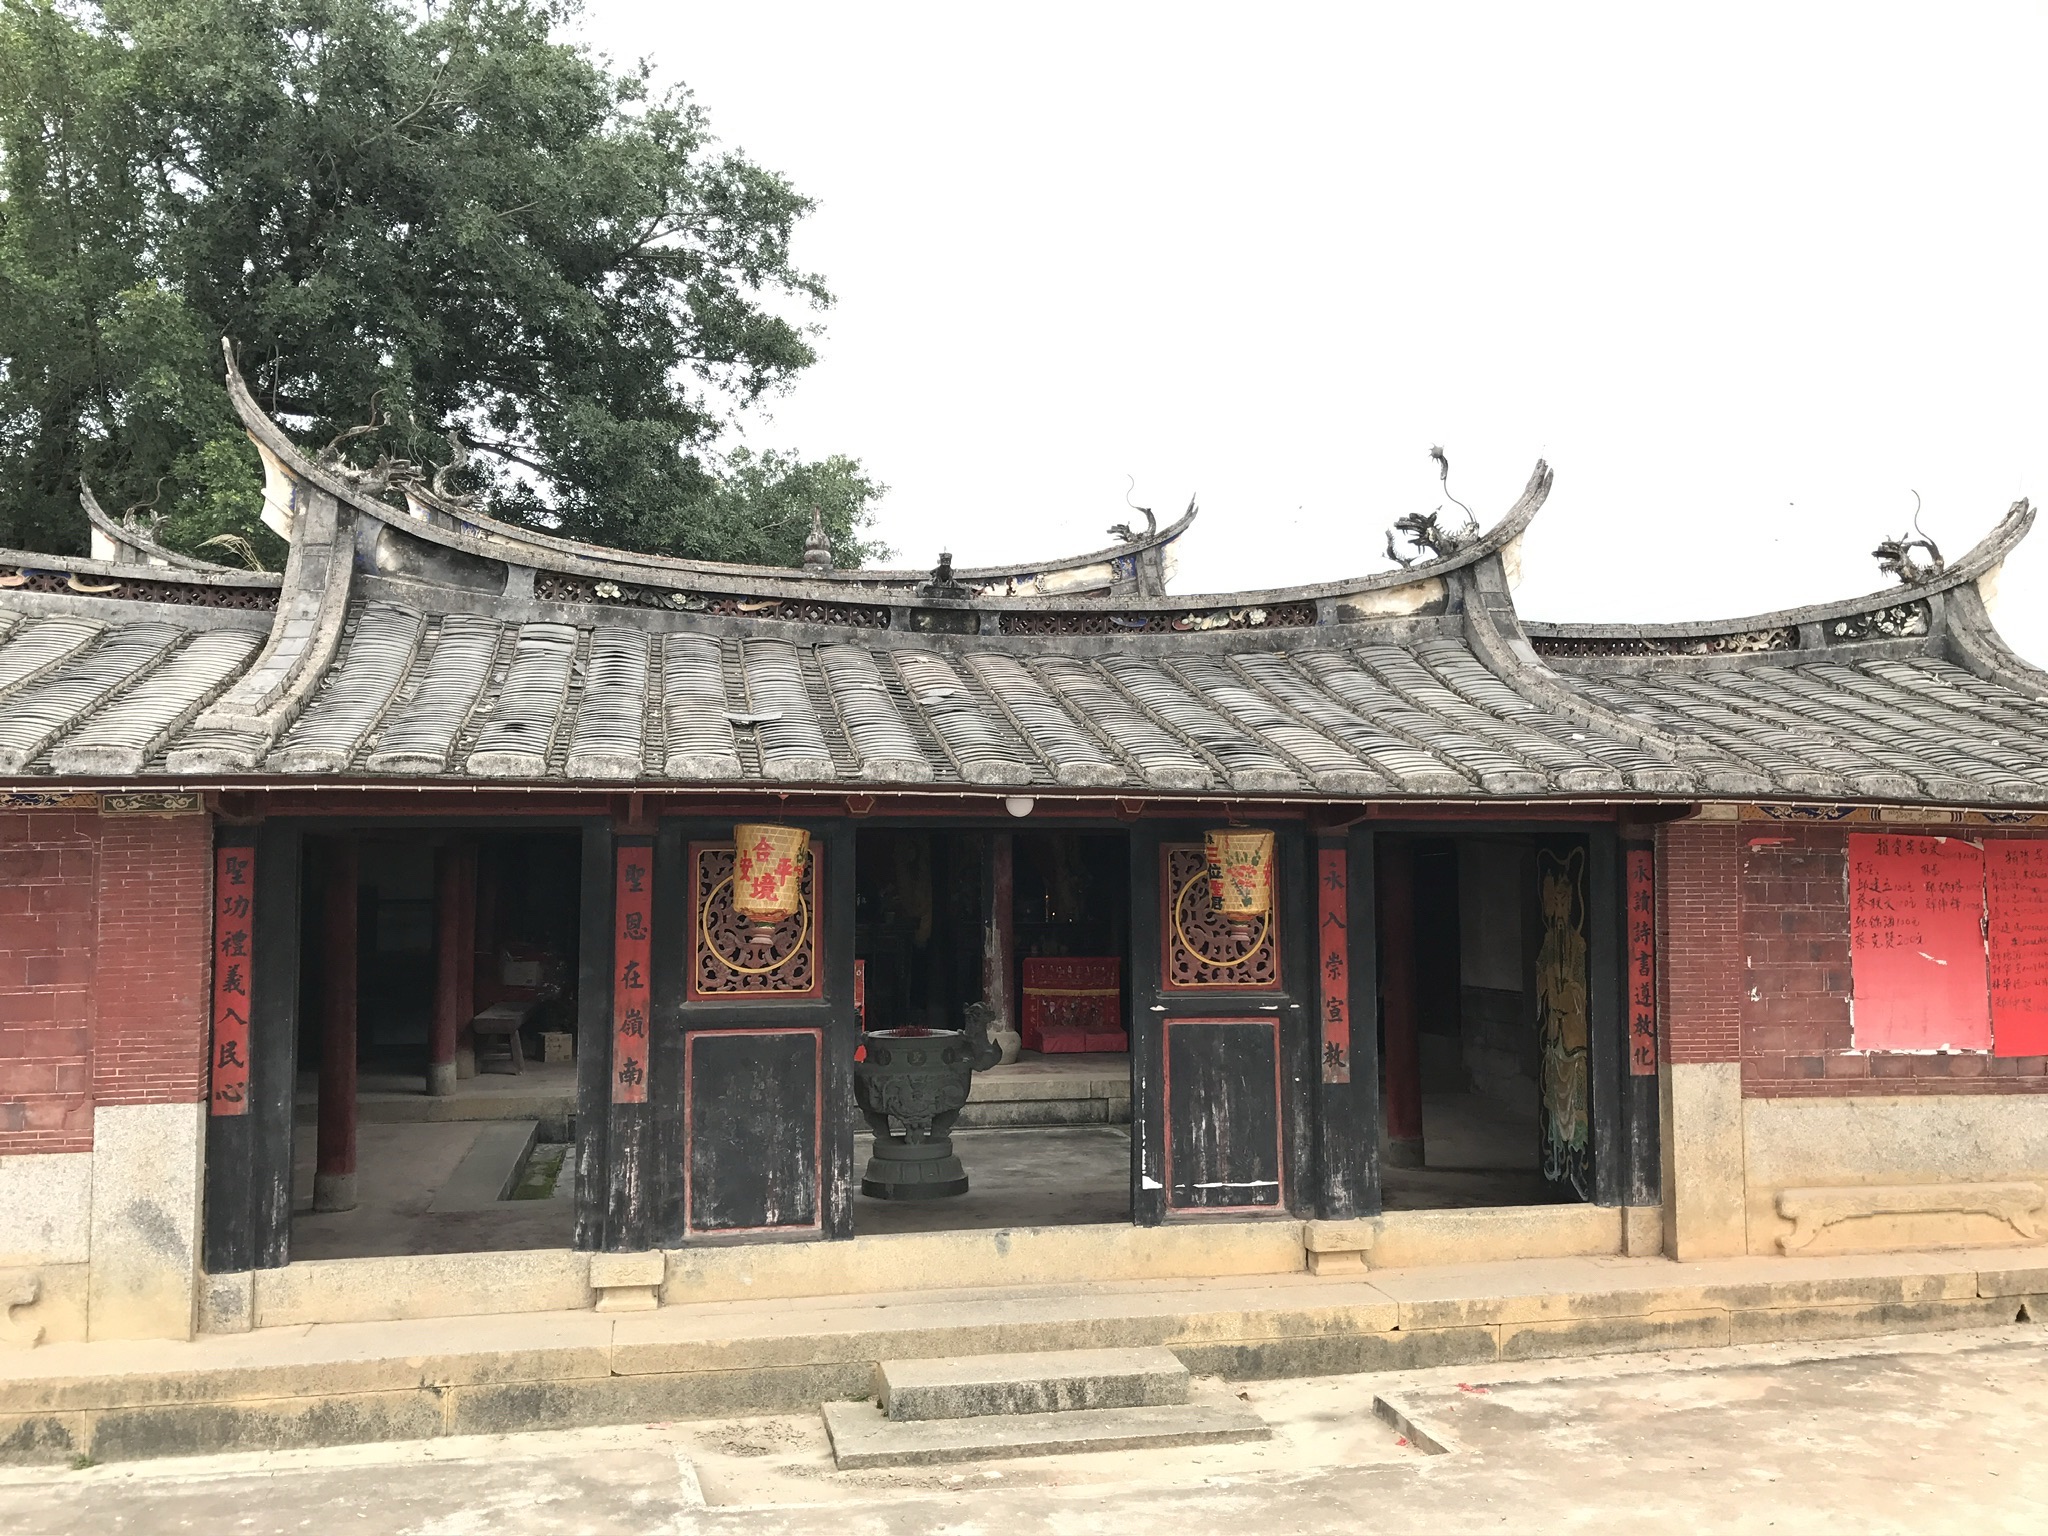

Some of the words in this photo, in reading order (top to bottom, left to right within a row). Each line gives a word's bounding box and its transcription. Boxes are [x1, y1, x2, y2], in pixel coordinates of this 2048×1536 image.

[215, 856, 250, 1103] 聖功禮義入民心
[618, 863, 648, 1087] 聖恩在嶺南
[1632, 858, 1655, 1067] 永讀詩書遵教化
